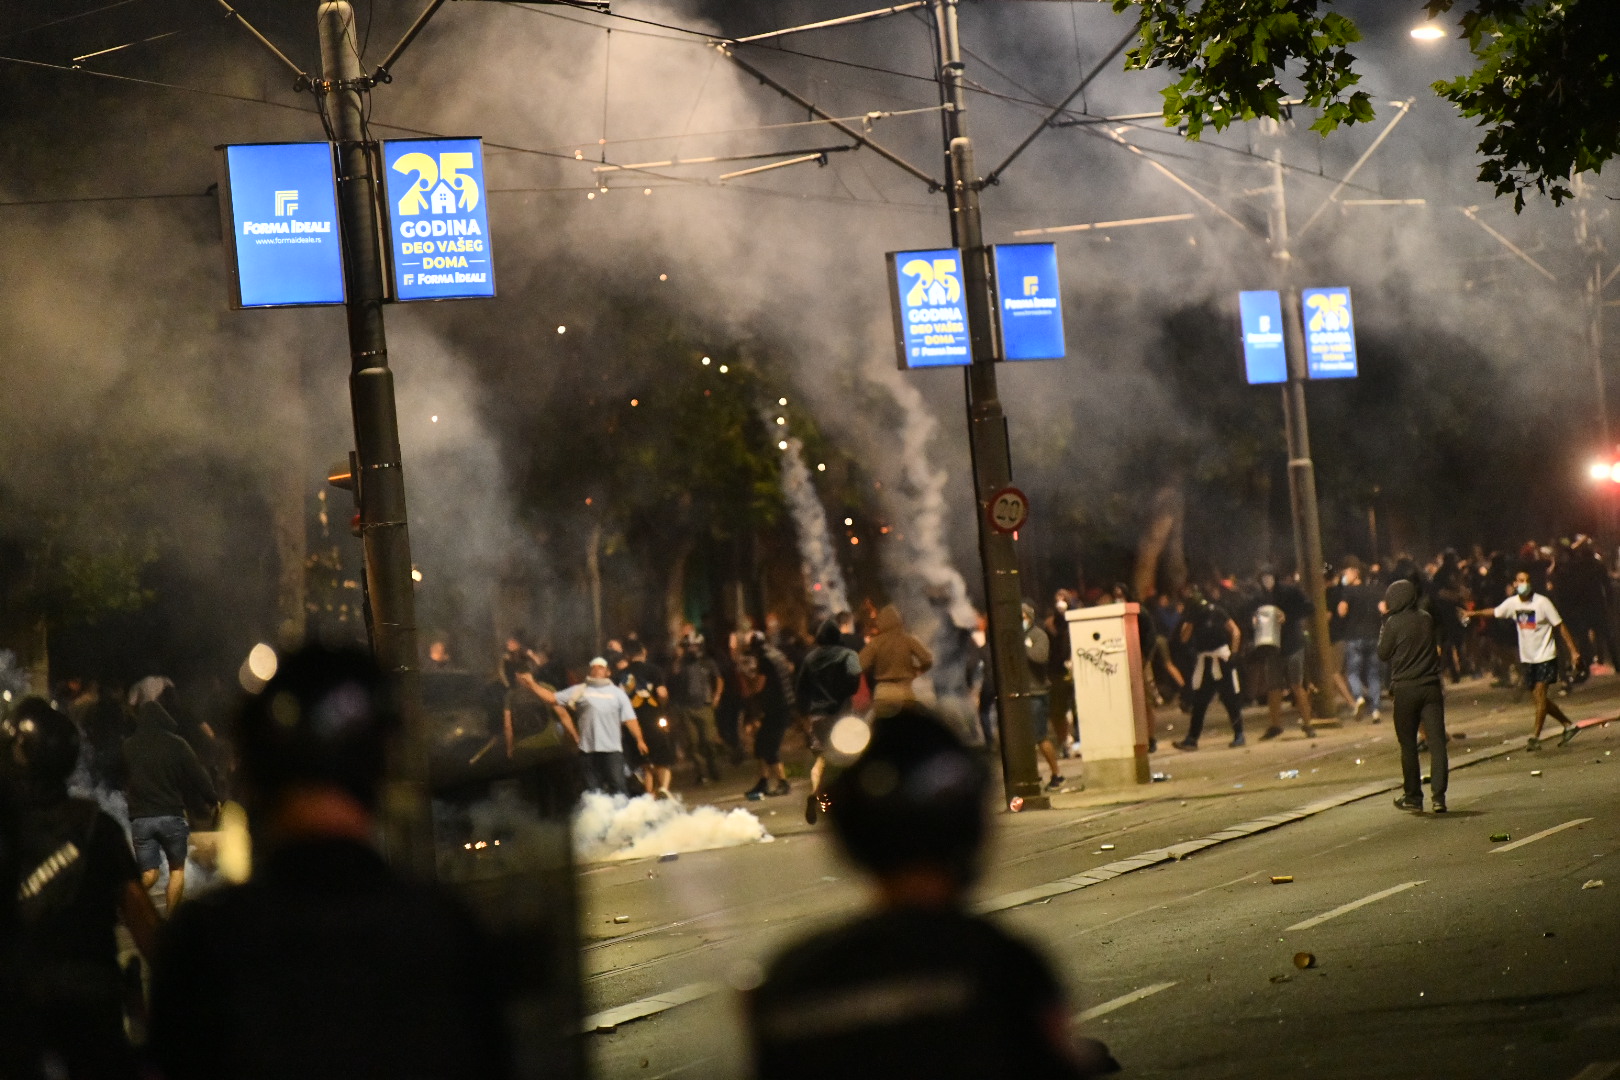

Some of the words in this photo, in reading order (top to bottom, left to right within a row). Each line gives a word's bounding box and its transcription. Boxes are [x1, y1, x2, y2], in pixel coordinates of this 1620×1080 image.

[392, 152, 479, 216] 25
[243, 221, 290, 235] FORMA
[290, 219, 331, 233] IDEALE
[400, 219, 482, 238] GODINA
[255, 236, 322, 245] www.formaideale.rs
[401, 241, 435, 255] DEO
[436, 237, 483, 253] VAŠEG
[422, 256, 469, 270] DOMA
[417, 273, 455, 285] FORMA
[902, 259, 960, 306] 25
[1306, 293, 1350, 332] 25
[996, 498, 1021, 522] 20
